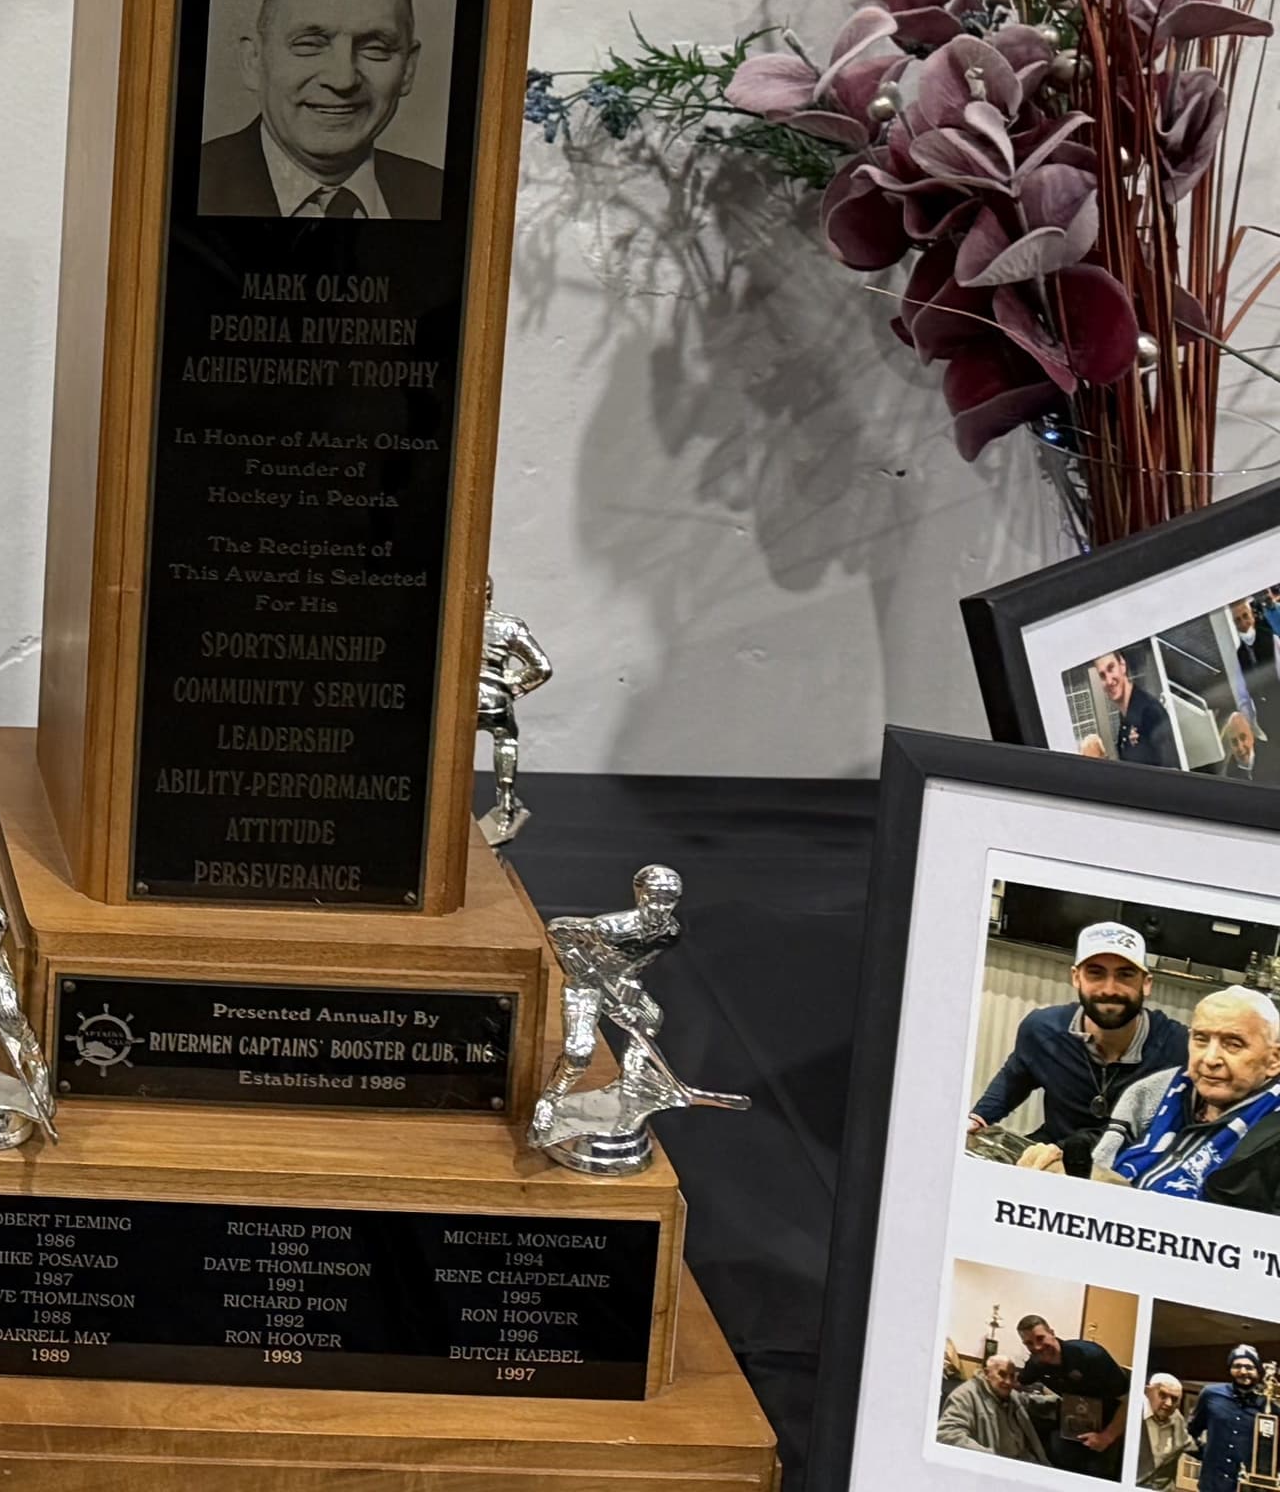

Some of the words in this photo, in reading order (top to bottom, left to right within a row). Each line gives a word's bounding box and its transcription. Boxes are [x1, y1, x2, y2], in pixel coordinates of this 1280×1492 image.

[242, 274, 306, 301] MARK
[315, 276, 389, 304] OLSON
[210, 316, 291, 343] PEORIA
[301, 318, 417, 346] RIVERMEN
[182, 356, 338, 386] ACHIEVEMENT
[348, 360, 439, 388] TROPHY
[201, 631, 386, 662] SPORTSMANSHIP
[174, 677, 303, 707] COMMUNITY
[314, 681, 405, 709] SERVICE
[217, 725, 354, 752] LEADERSHIP
[156, 769, 411, 801] ABILITY-PERFORMANCE
[225, 817, 335, 845] ATTITUDE
[194, 860, 361, 891] PERSEVERANCE
[213, 1003, 310, 1021] Presented
[317, 1008, 407, 1027] Annually
[414, 1011, 439, 1028] By
[149, 1032, 232, 1054] RIVERMEN
[240, 1036, 323, 1058] CAPTAINS'
[331, 1040, 404, 1061] BOOSTER
[411, 1042, 458, 1064] CLUB,
[465, 1042, 496, 1063] INC.
[240, 1070, 352, 1089] Established
[360, 1075, 406, 1091] 1986
[55, 1215, 132, 1231] FLEMING
[227, 1222, 305, 1238] RICHARD
[311, 1225, 352, 1240] PION
[36, 1233, 75, 1248] 1986
[443, 1230, 512, 1246] MICHEL
[517, 1233, 607, 1249] MONGEAU
[995, 1200, 1241, 1270] REMEMBERING
[270, 1242, 309, 1256] 1990
[38, 1253, 118, 1269] POSAVAD
[204, 1257, 251, 1273] DAVE
[256, 1260, 371, 1277] THOMLINSON
[504, 1252, 543, 1267] 1994
[34, 1272, 73, 1286] 1987
[268, 1278, 305, 1292] 1991
[435, 1269, 482, 1284] RENE
[487, 1271, 610, 1288] CHAPDELAINE
[21, 1290, 135, 1308] THOMLINSON
[223, 1295, 302, 1311] RICHARD
[307, 1298, 348, 1312] PION
[502, 1290, 541, 1305] 1995
[33, 1310, 71, 1324] 1988
[266, 1314, 304, 1328] 1992
[461, 1308, 498, 1323] RON
[504, 1310, 578, 1326] HOOVER
[74, 1331, 111, 1345] MAY
[225, 1330, 262, 1345] RON
[267, 1333, 342, 1348] HOOVER
[499, 1329, 538, 1344] 1996
[31, 1348, 70, 1363] 1989
[263, 1349, 302, 1364] 1993
[449, 1345, 509, 1361] BUTCH
[515, 1348, 584, 1364] KAEBEL
[496, 1367, 536, 1382] 1997
